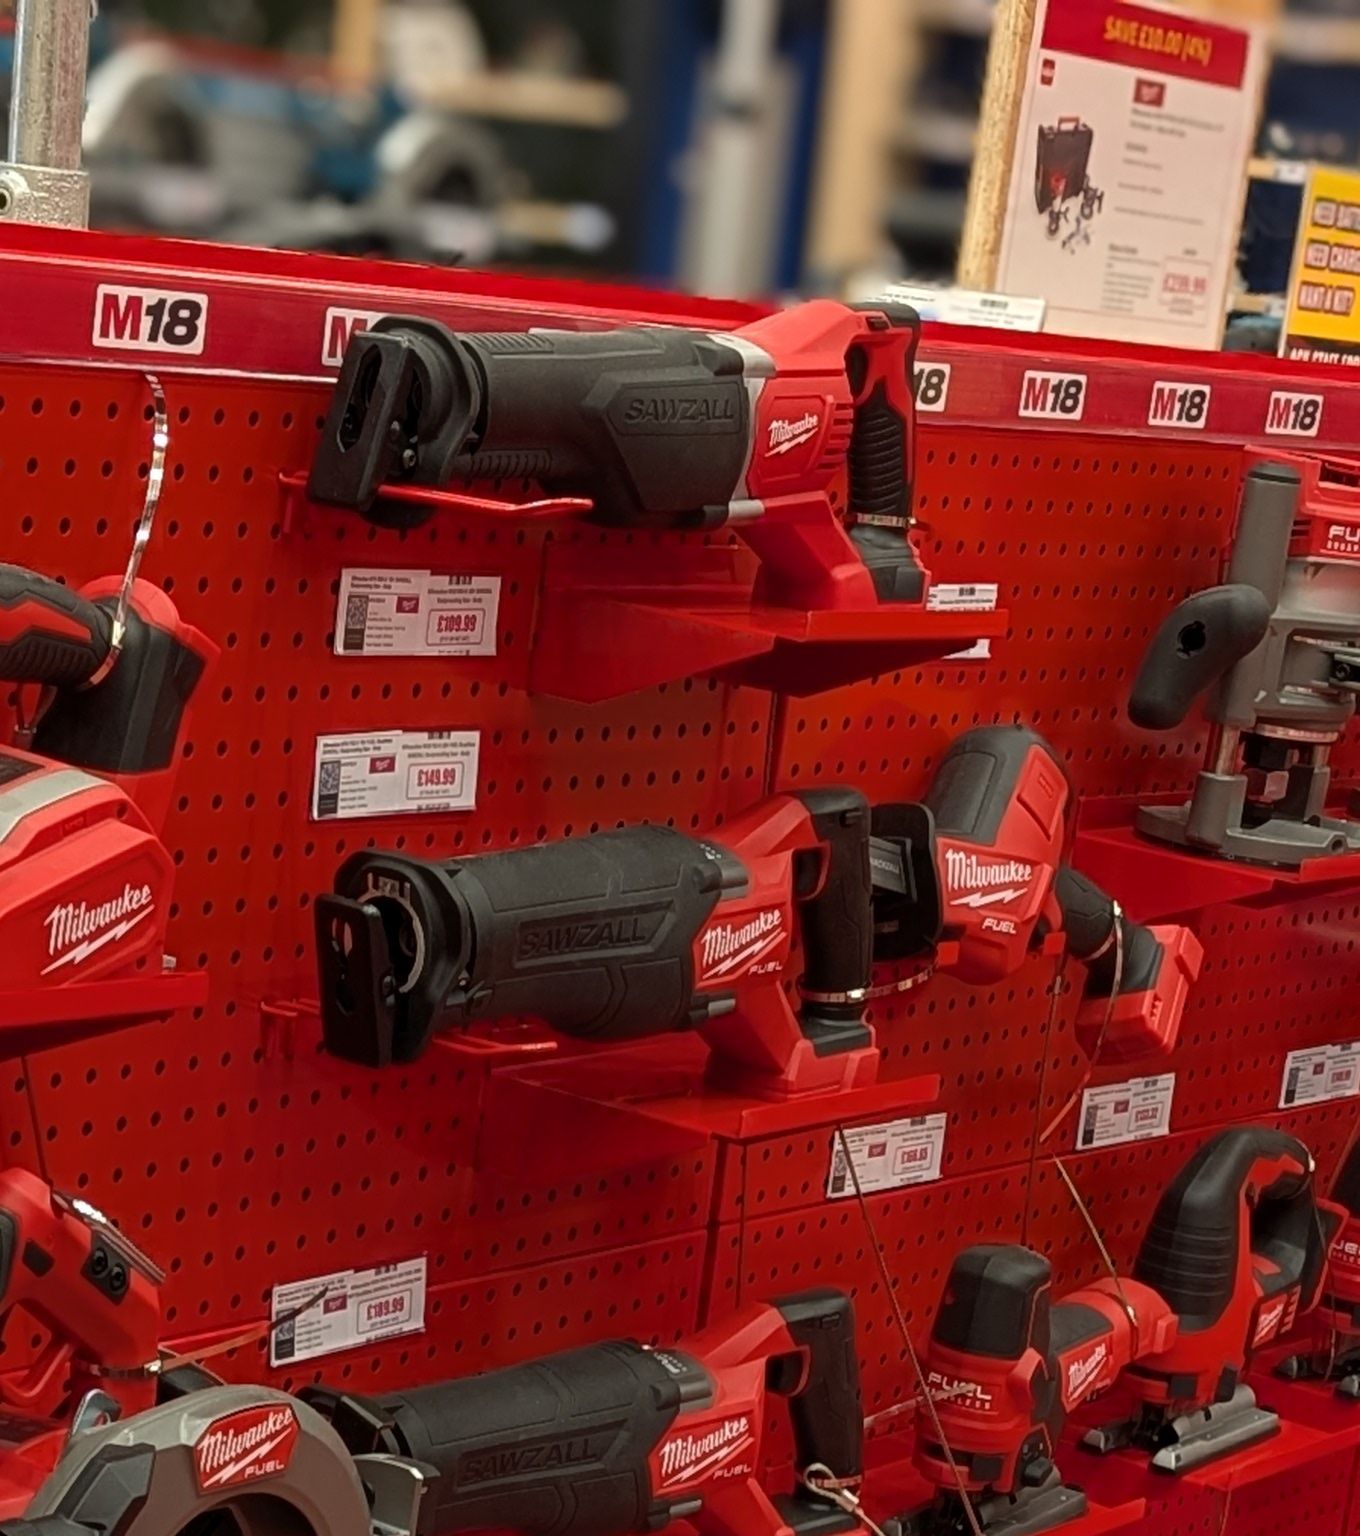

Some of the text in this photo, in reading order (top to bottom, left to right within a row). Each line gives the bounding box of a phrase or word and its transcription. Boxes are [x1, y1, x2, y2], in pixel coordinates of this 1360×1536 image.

[100, 294, 200, 346] M18
[625, 399, 733, 423] SAWZALL
[1025, 378, 1081, 414] M18
[1153, 387, 1206, 423] M18
[768, 413, 818, 447] Milwaukee
[1270, 398, 1319, 432] M18
[945, 849, 1032, 891] Milwaukee
[44, 883, 152, 956] Milwaukee
[702, 909, 782, 966] Milwaukee
[983, 918, 1017, 934] FUEL
[520, 918, 646, 961] SAWZALL
[749, 962, 783, 976] FUEL
[197, 1409, 293, 1473] Milwaukee
[660, 1417, 749, 1476] Milwaukee
[245, 1460, 284, 1478] FUEL
[463, 1439, 597, 1482] SAWZALL
[713, 1465, 751, 1479] FUEL
